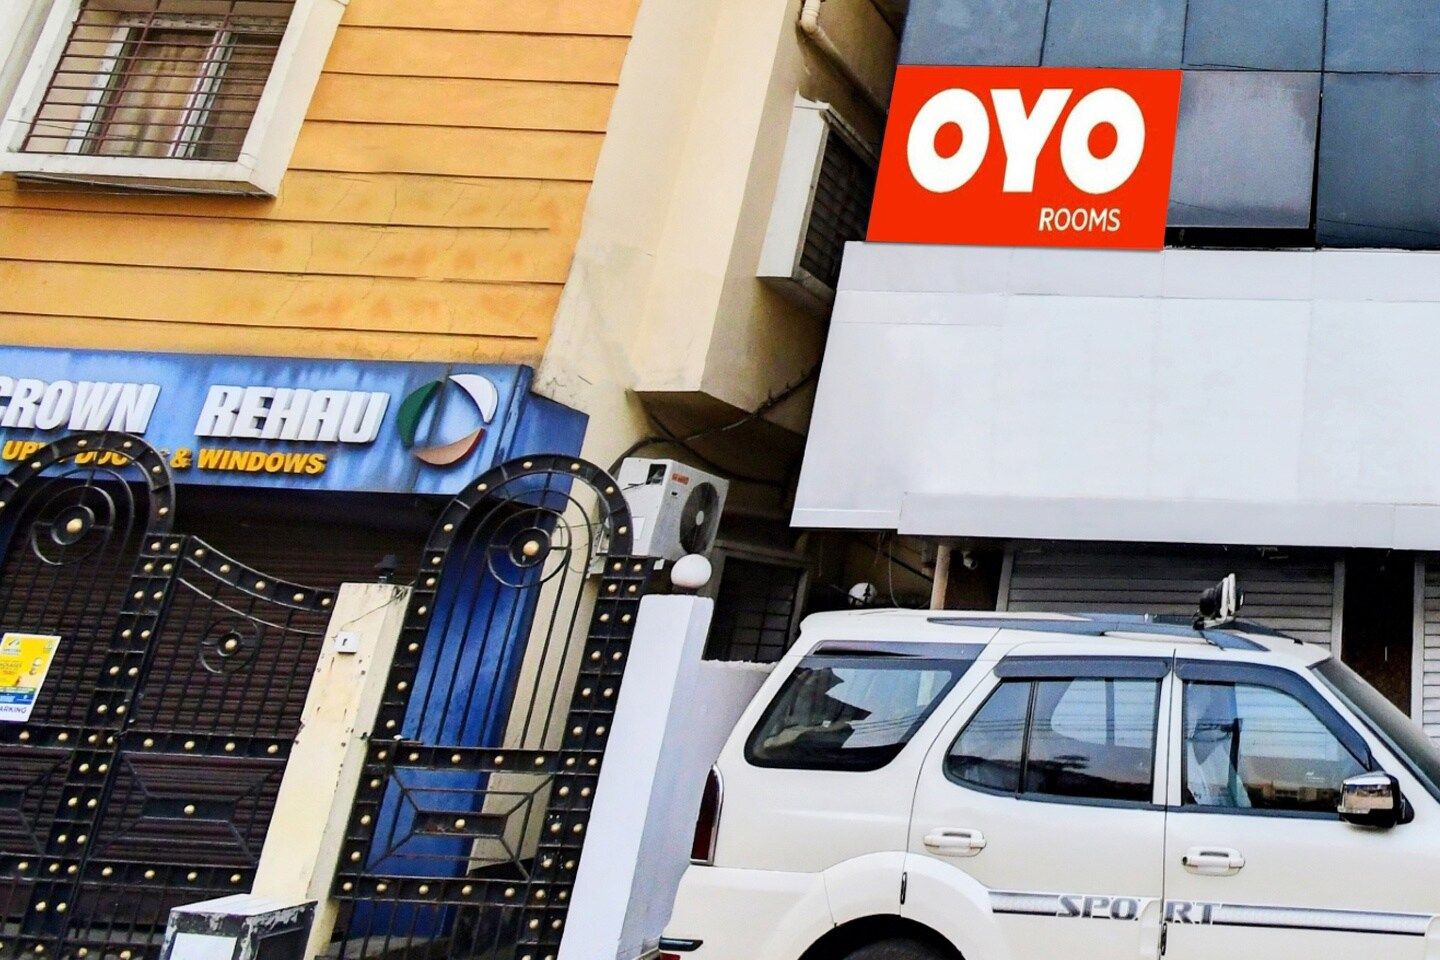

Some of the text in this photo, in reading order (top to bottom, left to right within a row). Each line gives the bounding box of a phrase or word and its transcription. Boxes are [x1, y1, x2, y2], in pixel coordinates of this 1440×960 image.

[907, 87, 1146, 195] OYO
[1038, 207, 1121, 232] ROOMS
[194, 385, 391, 443] REHAU
[169, 447, 192, 469] &
[197, 448, 327, 475] WINDOWS
[1057, 895, 1221, 925] SPORT
